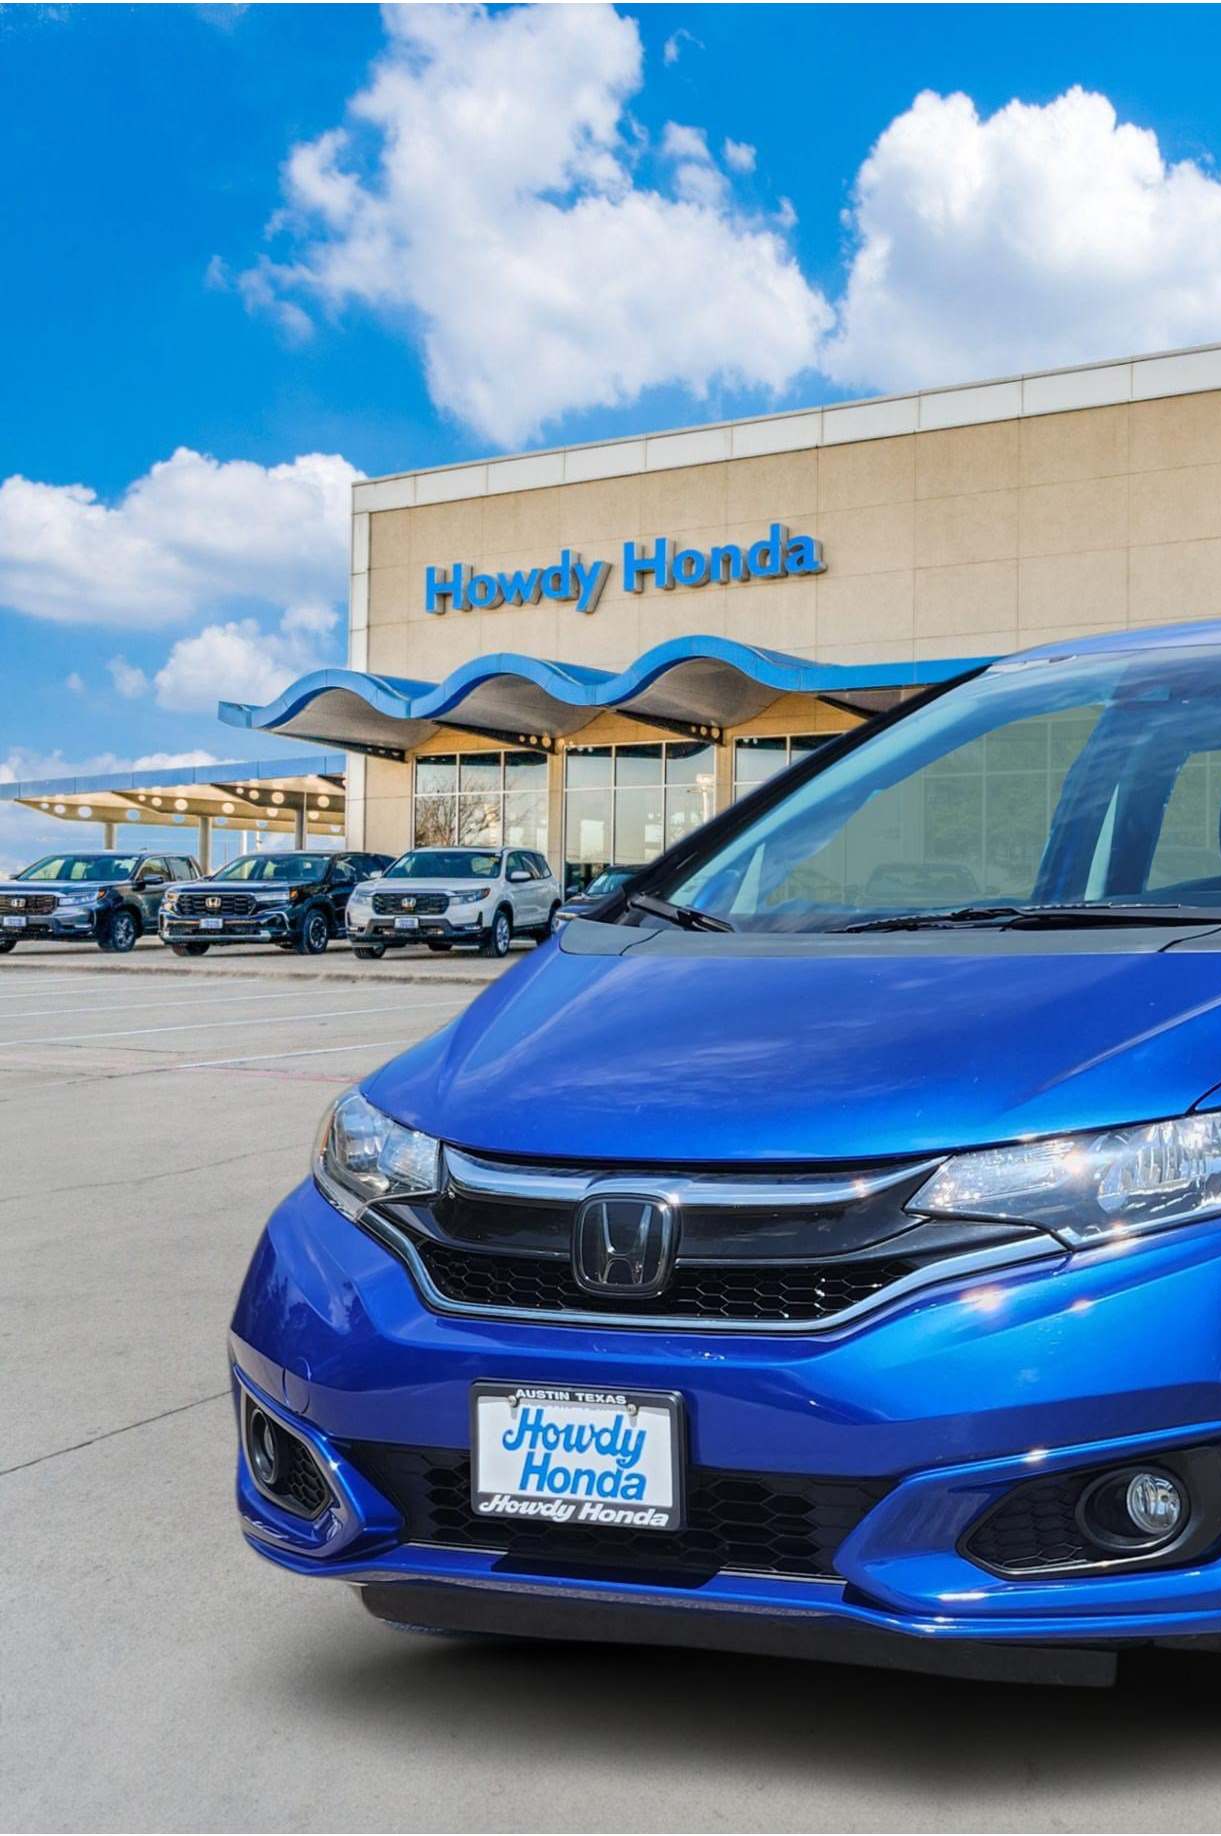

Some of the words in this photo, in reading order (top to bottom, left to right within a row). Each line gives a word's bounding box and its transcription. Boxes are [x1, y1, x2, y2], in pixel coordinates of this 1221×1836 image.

[425, 548, 612, 614] Howdy
[623, 523, 827, 593] Honda
[515, 1388, 570, 1401] AUSTIN
[575, 1392, 627, 1405] TEXAS
[502, 1407, 647, 1469] Howdy
[518, 1451, 647, 1501] Honda
[478, 1494, 575, 1522] Howdy
[577, 1501, 669, 1527] Honda
